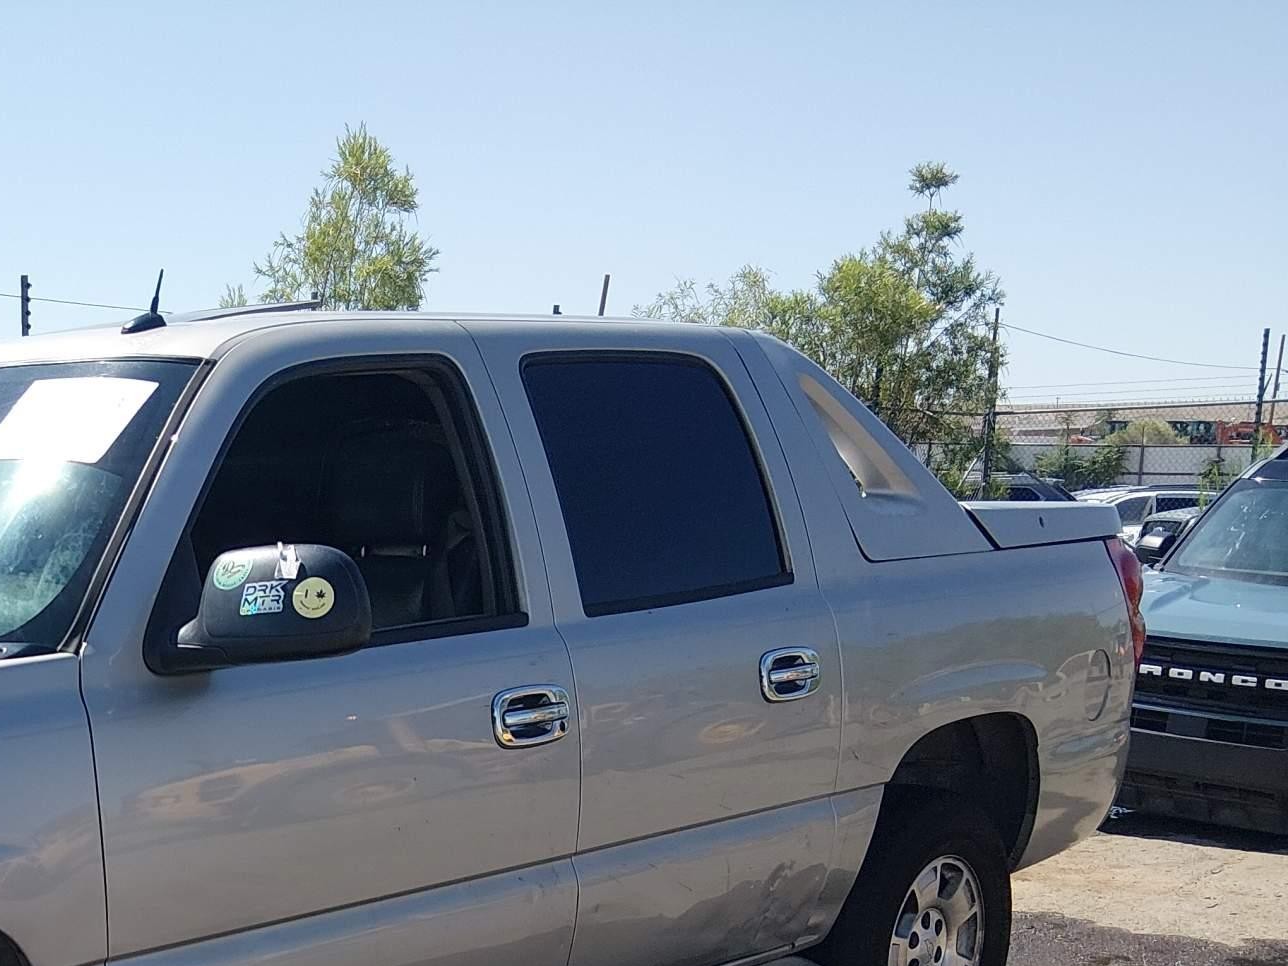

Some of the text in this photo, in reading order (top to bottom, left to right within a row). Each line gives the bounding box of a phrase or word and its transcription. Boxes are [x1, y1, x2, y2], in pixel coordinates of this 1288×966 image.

[244, 582, 283, 596] DRK
[242, 595, 282, 608] MTR
[1138, 663, 1288, 691] RONCO
